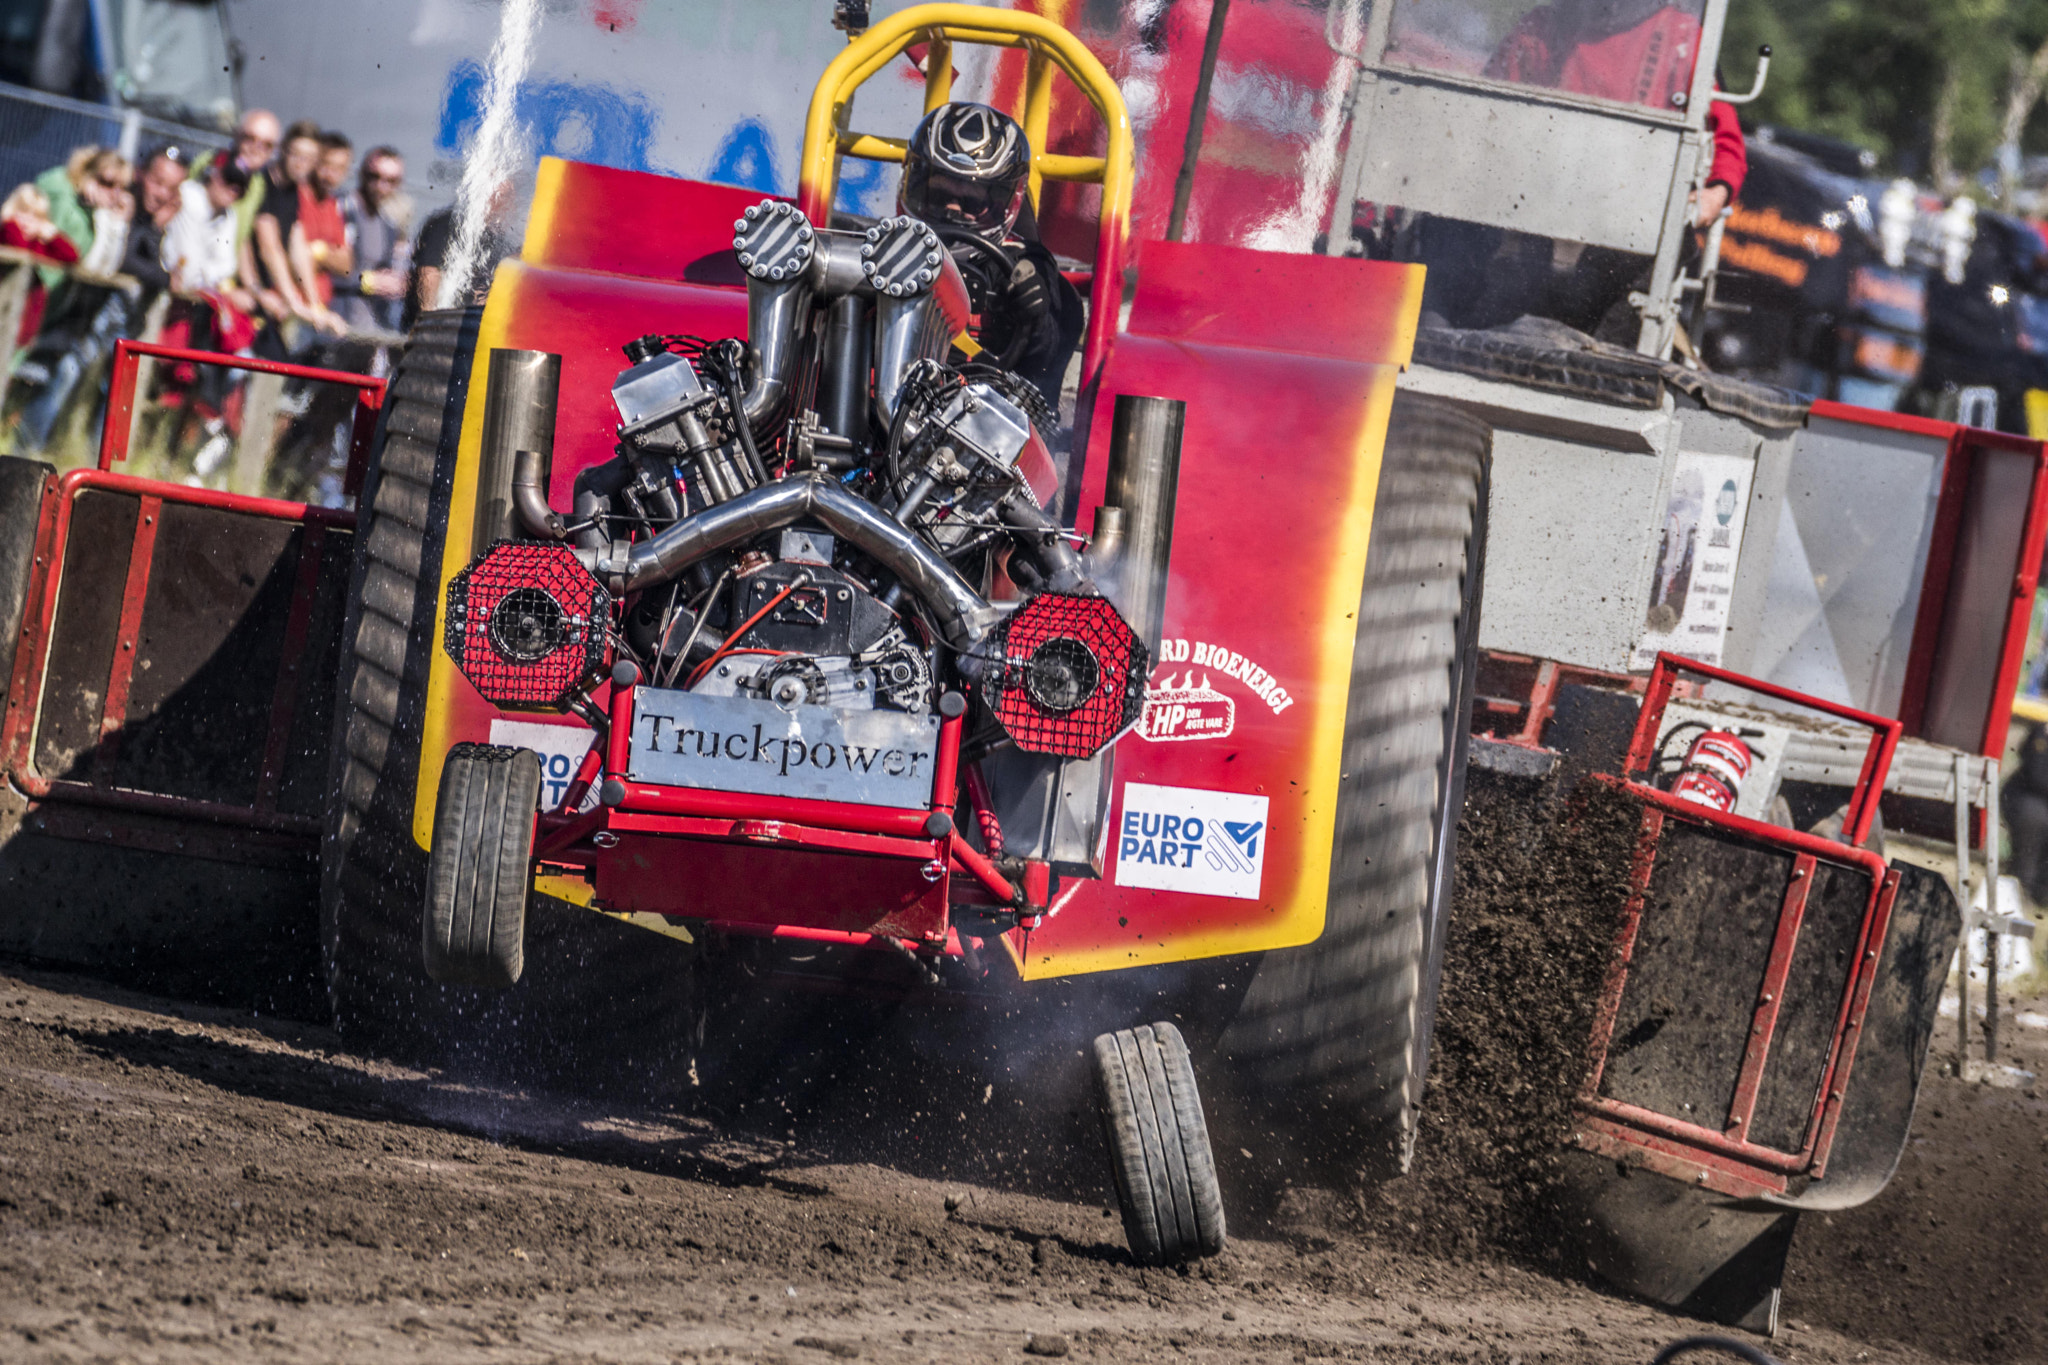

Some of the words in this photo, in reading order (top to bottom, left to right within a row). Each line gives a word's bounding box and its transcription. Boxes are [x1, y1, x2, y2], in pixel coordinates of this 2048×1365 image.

[1159, 638, 1190, 663] RD
[1192, 641, 1294, 716] BIOENERGI
[1151, 703, 1186, 736] HP
[1186, 708, 1202, 719] DEN
[1205, 716, 1223, 728] VARE
[640, 713, 929, 779] Truckpower
[1122, 810, 1205, 842] EURO
[1120, 836, 1203, 868] PART
